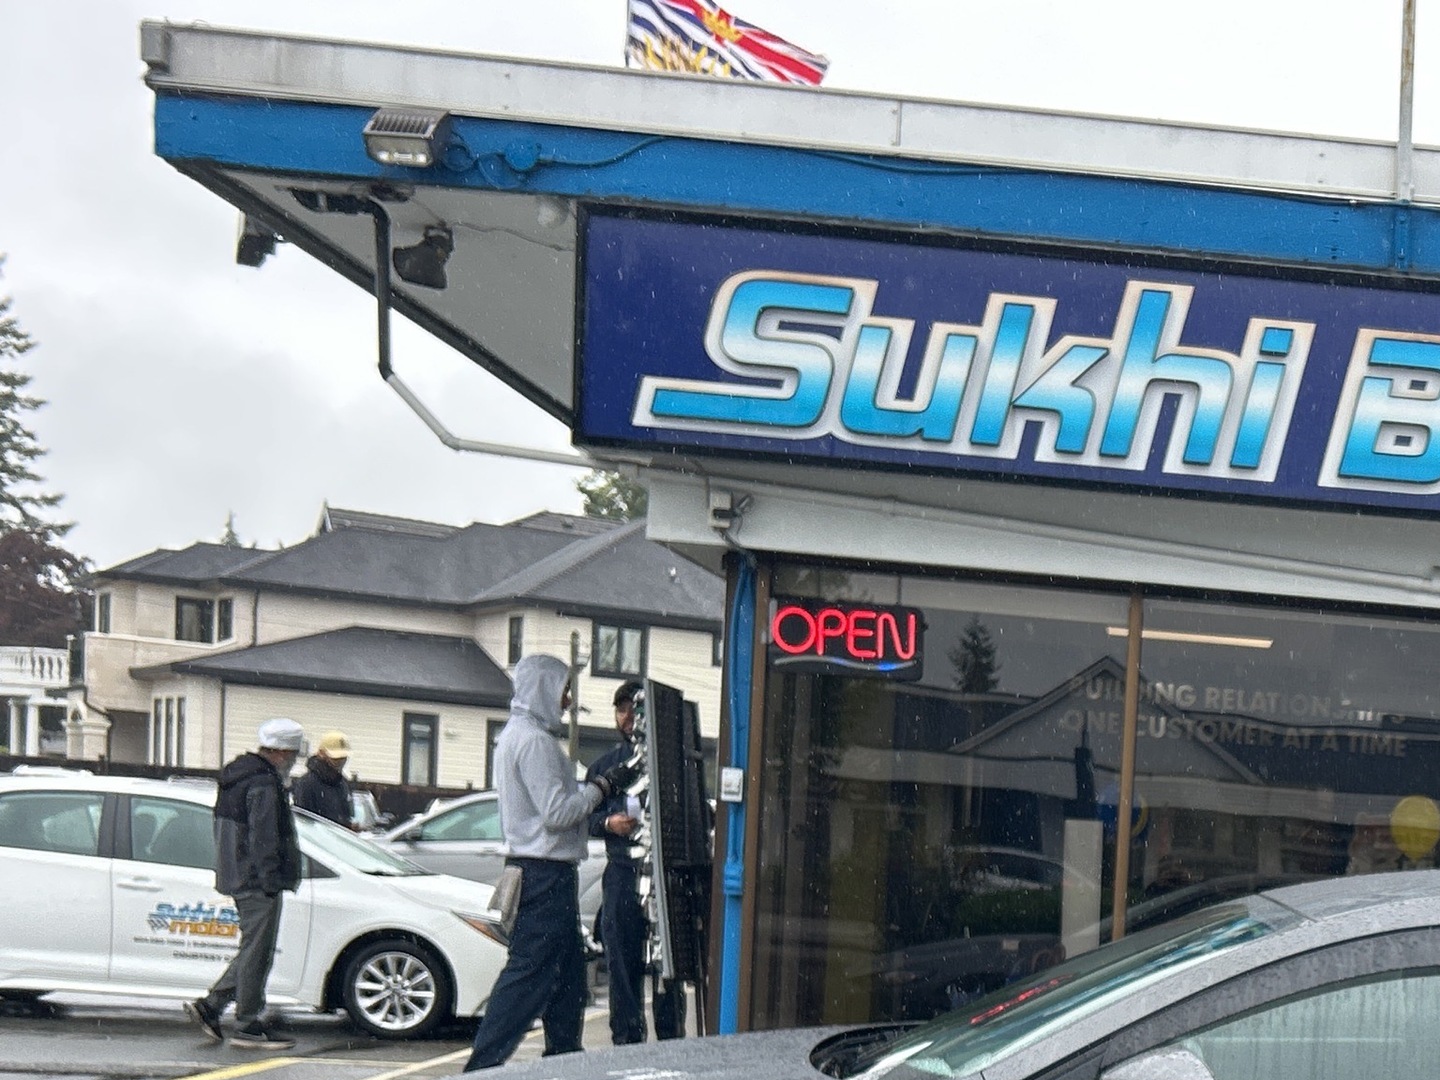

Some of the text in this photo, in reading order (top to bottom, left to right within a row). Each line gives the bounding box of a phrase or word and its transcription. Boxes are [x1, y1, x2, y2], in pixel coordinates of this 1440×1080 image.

[632, 270, 1316, 482] Sukhi
[771, 606, 917, 661] OPEN
[1071, 677, 1197, 708] UILING
[1347, 731, 1407, 758] TIME
